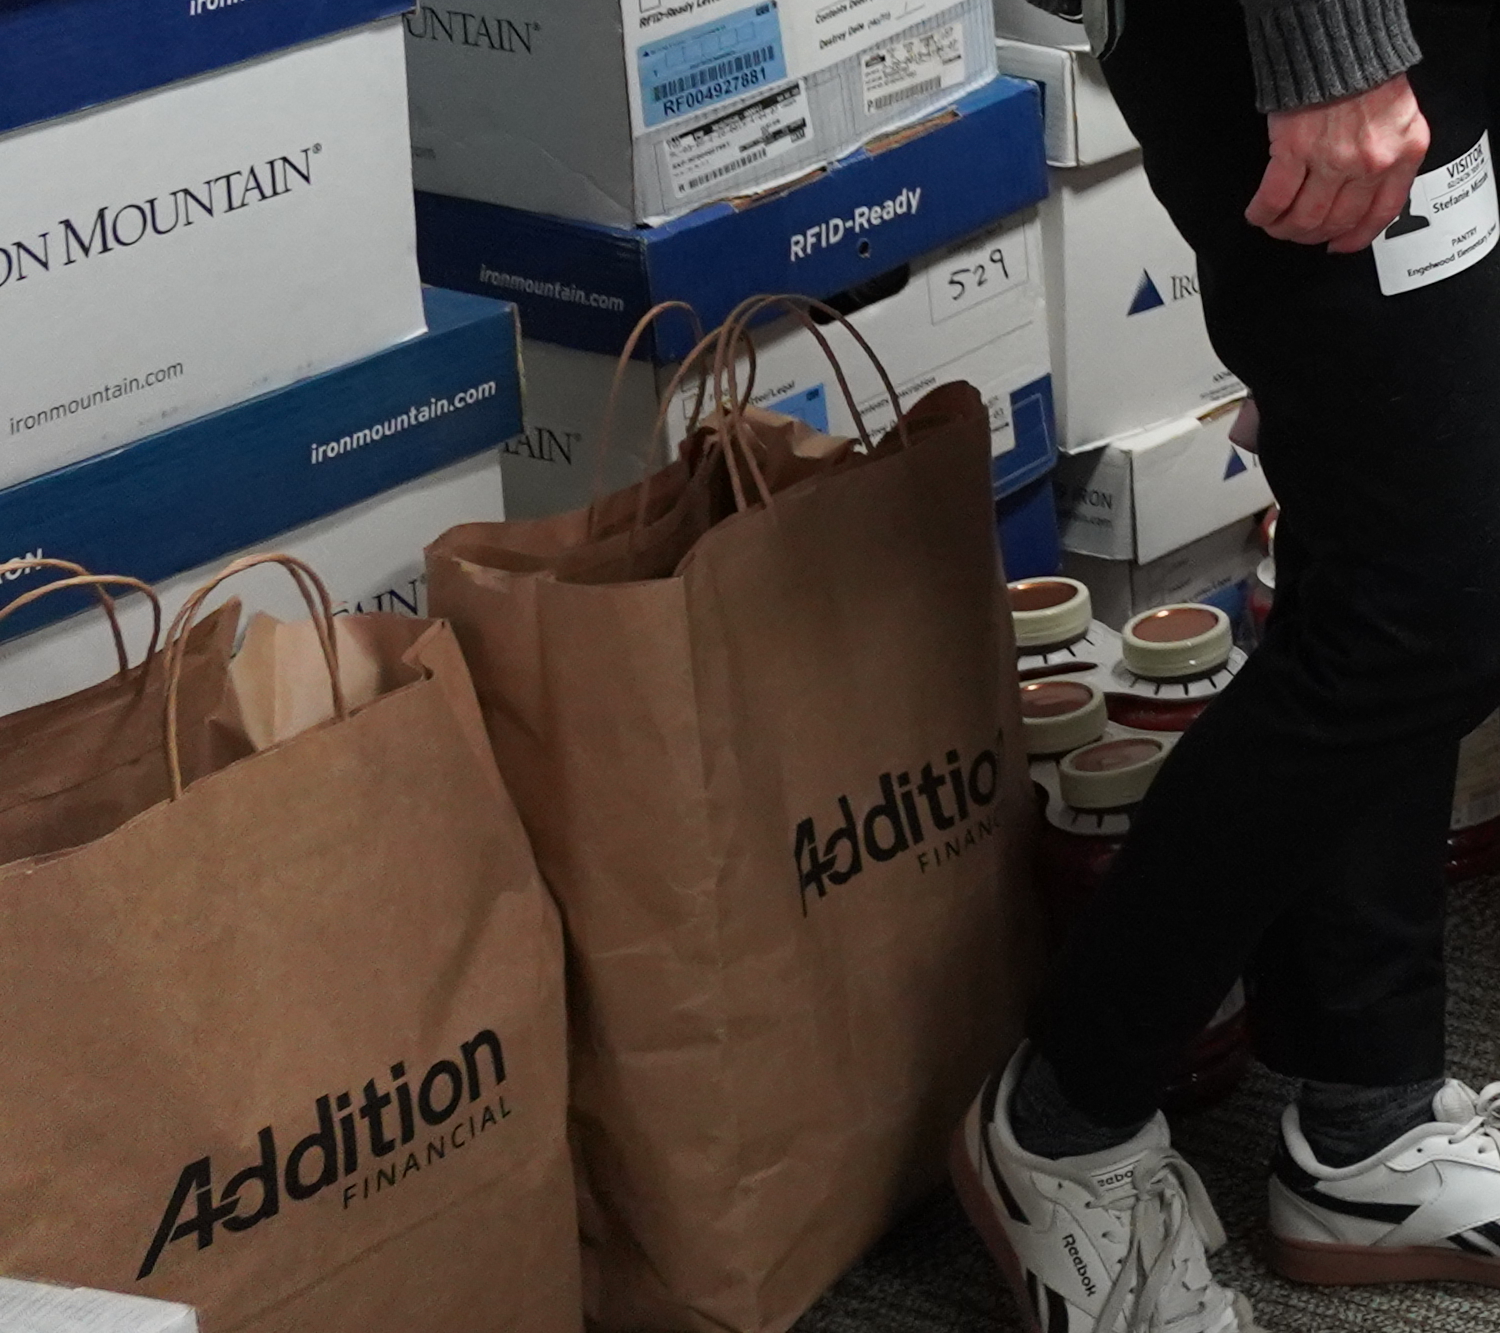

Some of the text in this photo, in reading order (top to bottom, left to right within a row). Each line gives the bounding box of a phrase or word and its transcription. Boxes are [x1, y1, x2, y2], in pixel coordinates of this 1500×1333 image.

[663, 66, 769, 117] RF004927881
[1446, 143, 1484, 179] VISITOR
[789, 186, 922, 264] RFID-Ready
[1451, 226, 1478, 247] PANTRY
[479, 264, 625, 313] ironmountain.com
[948, 248, 1010, 303] 529
[9, 360, 185, 436] ironmountain.com
[310, 379, 497, 465] ironmountain.com
[794, 748, 999, 919] Additio
[136, 1025, 508, 1283] Addition
[341, 1092, 514, 1212] FINANCIAL
[1062, 1233, 1097, 1298] Reebok
